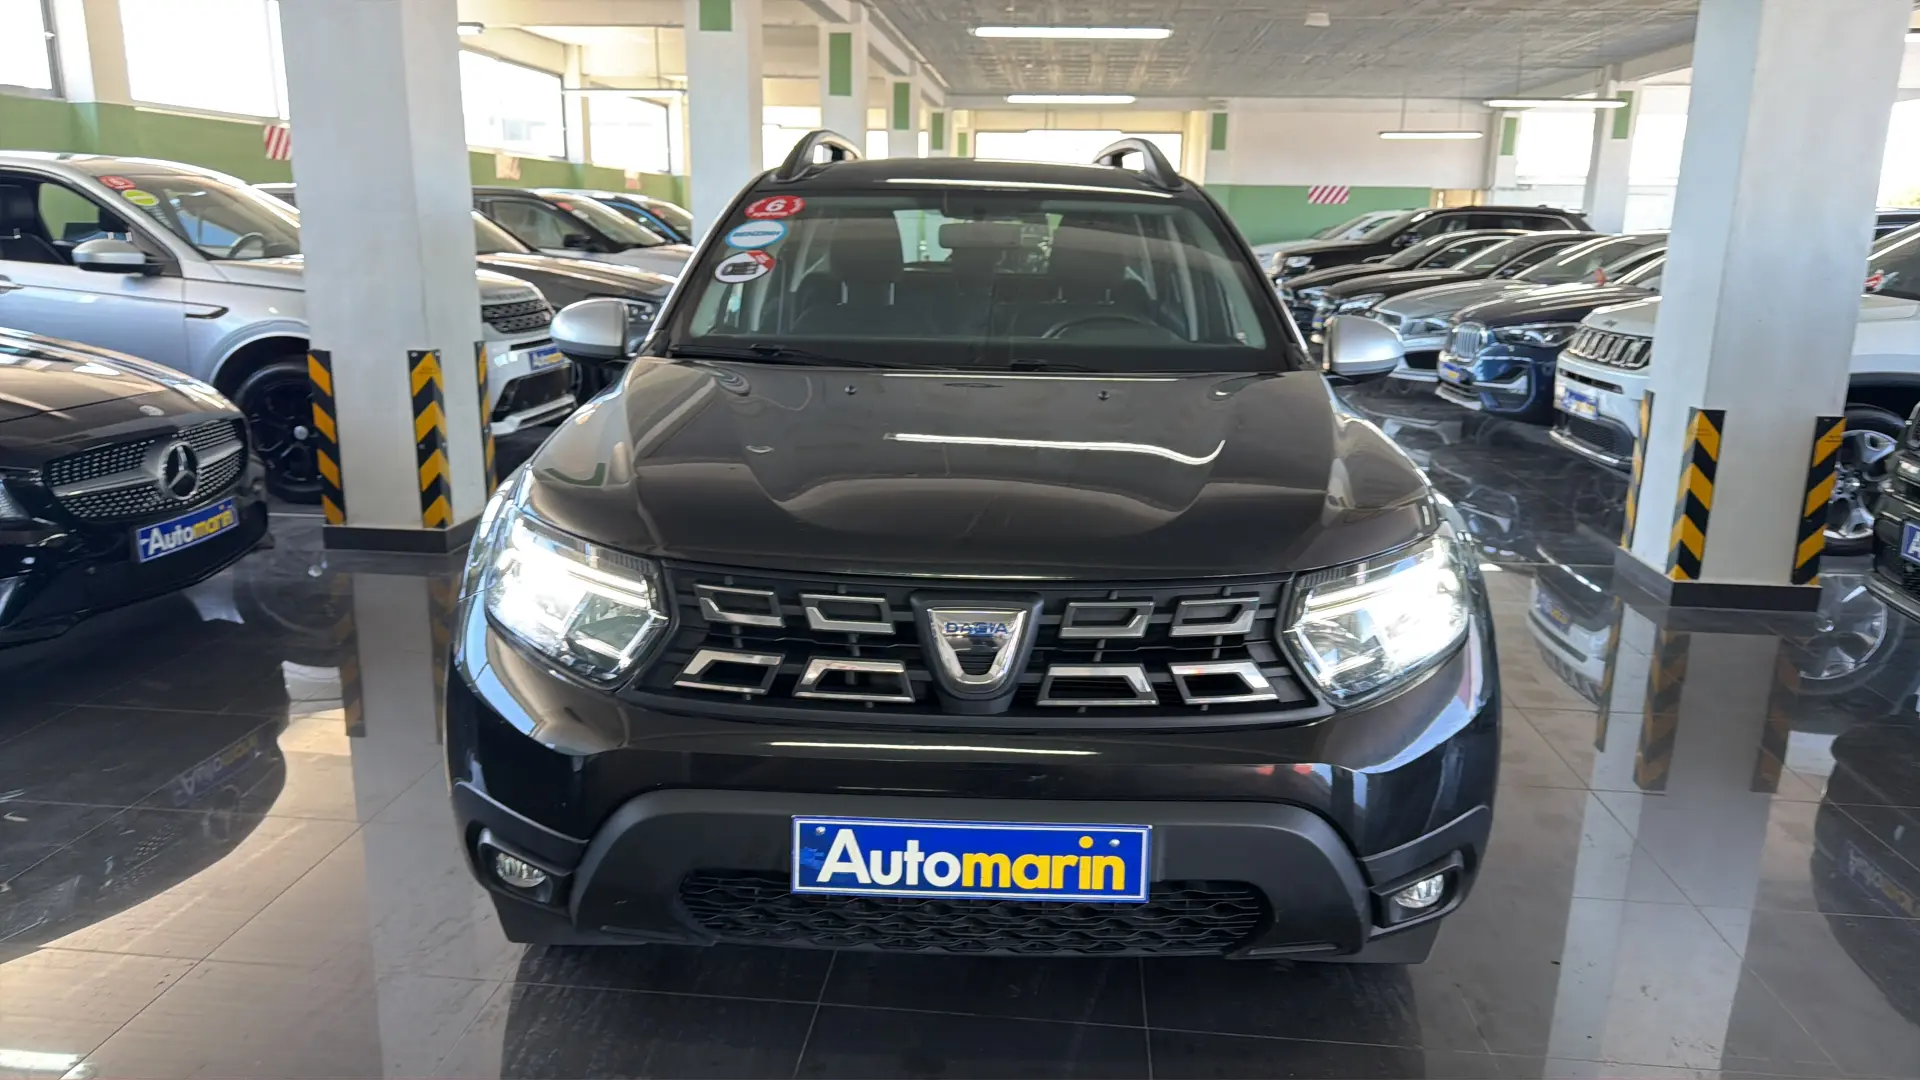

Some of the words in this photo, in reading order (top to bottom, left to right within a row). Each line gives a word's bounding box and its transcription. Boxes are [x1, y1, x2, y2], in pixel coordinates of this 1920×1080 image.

[765, 199, 787, 212] 6
[945, 622, 1008, 634] DACIA
[816, 828, 1126, 890] Automarin
